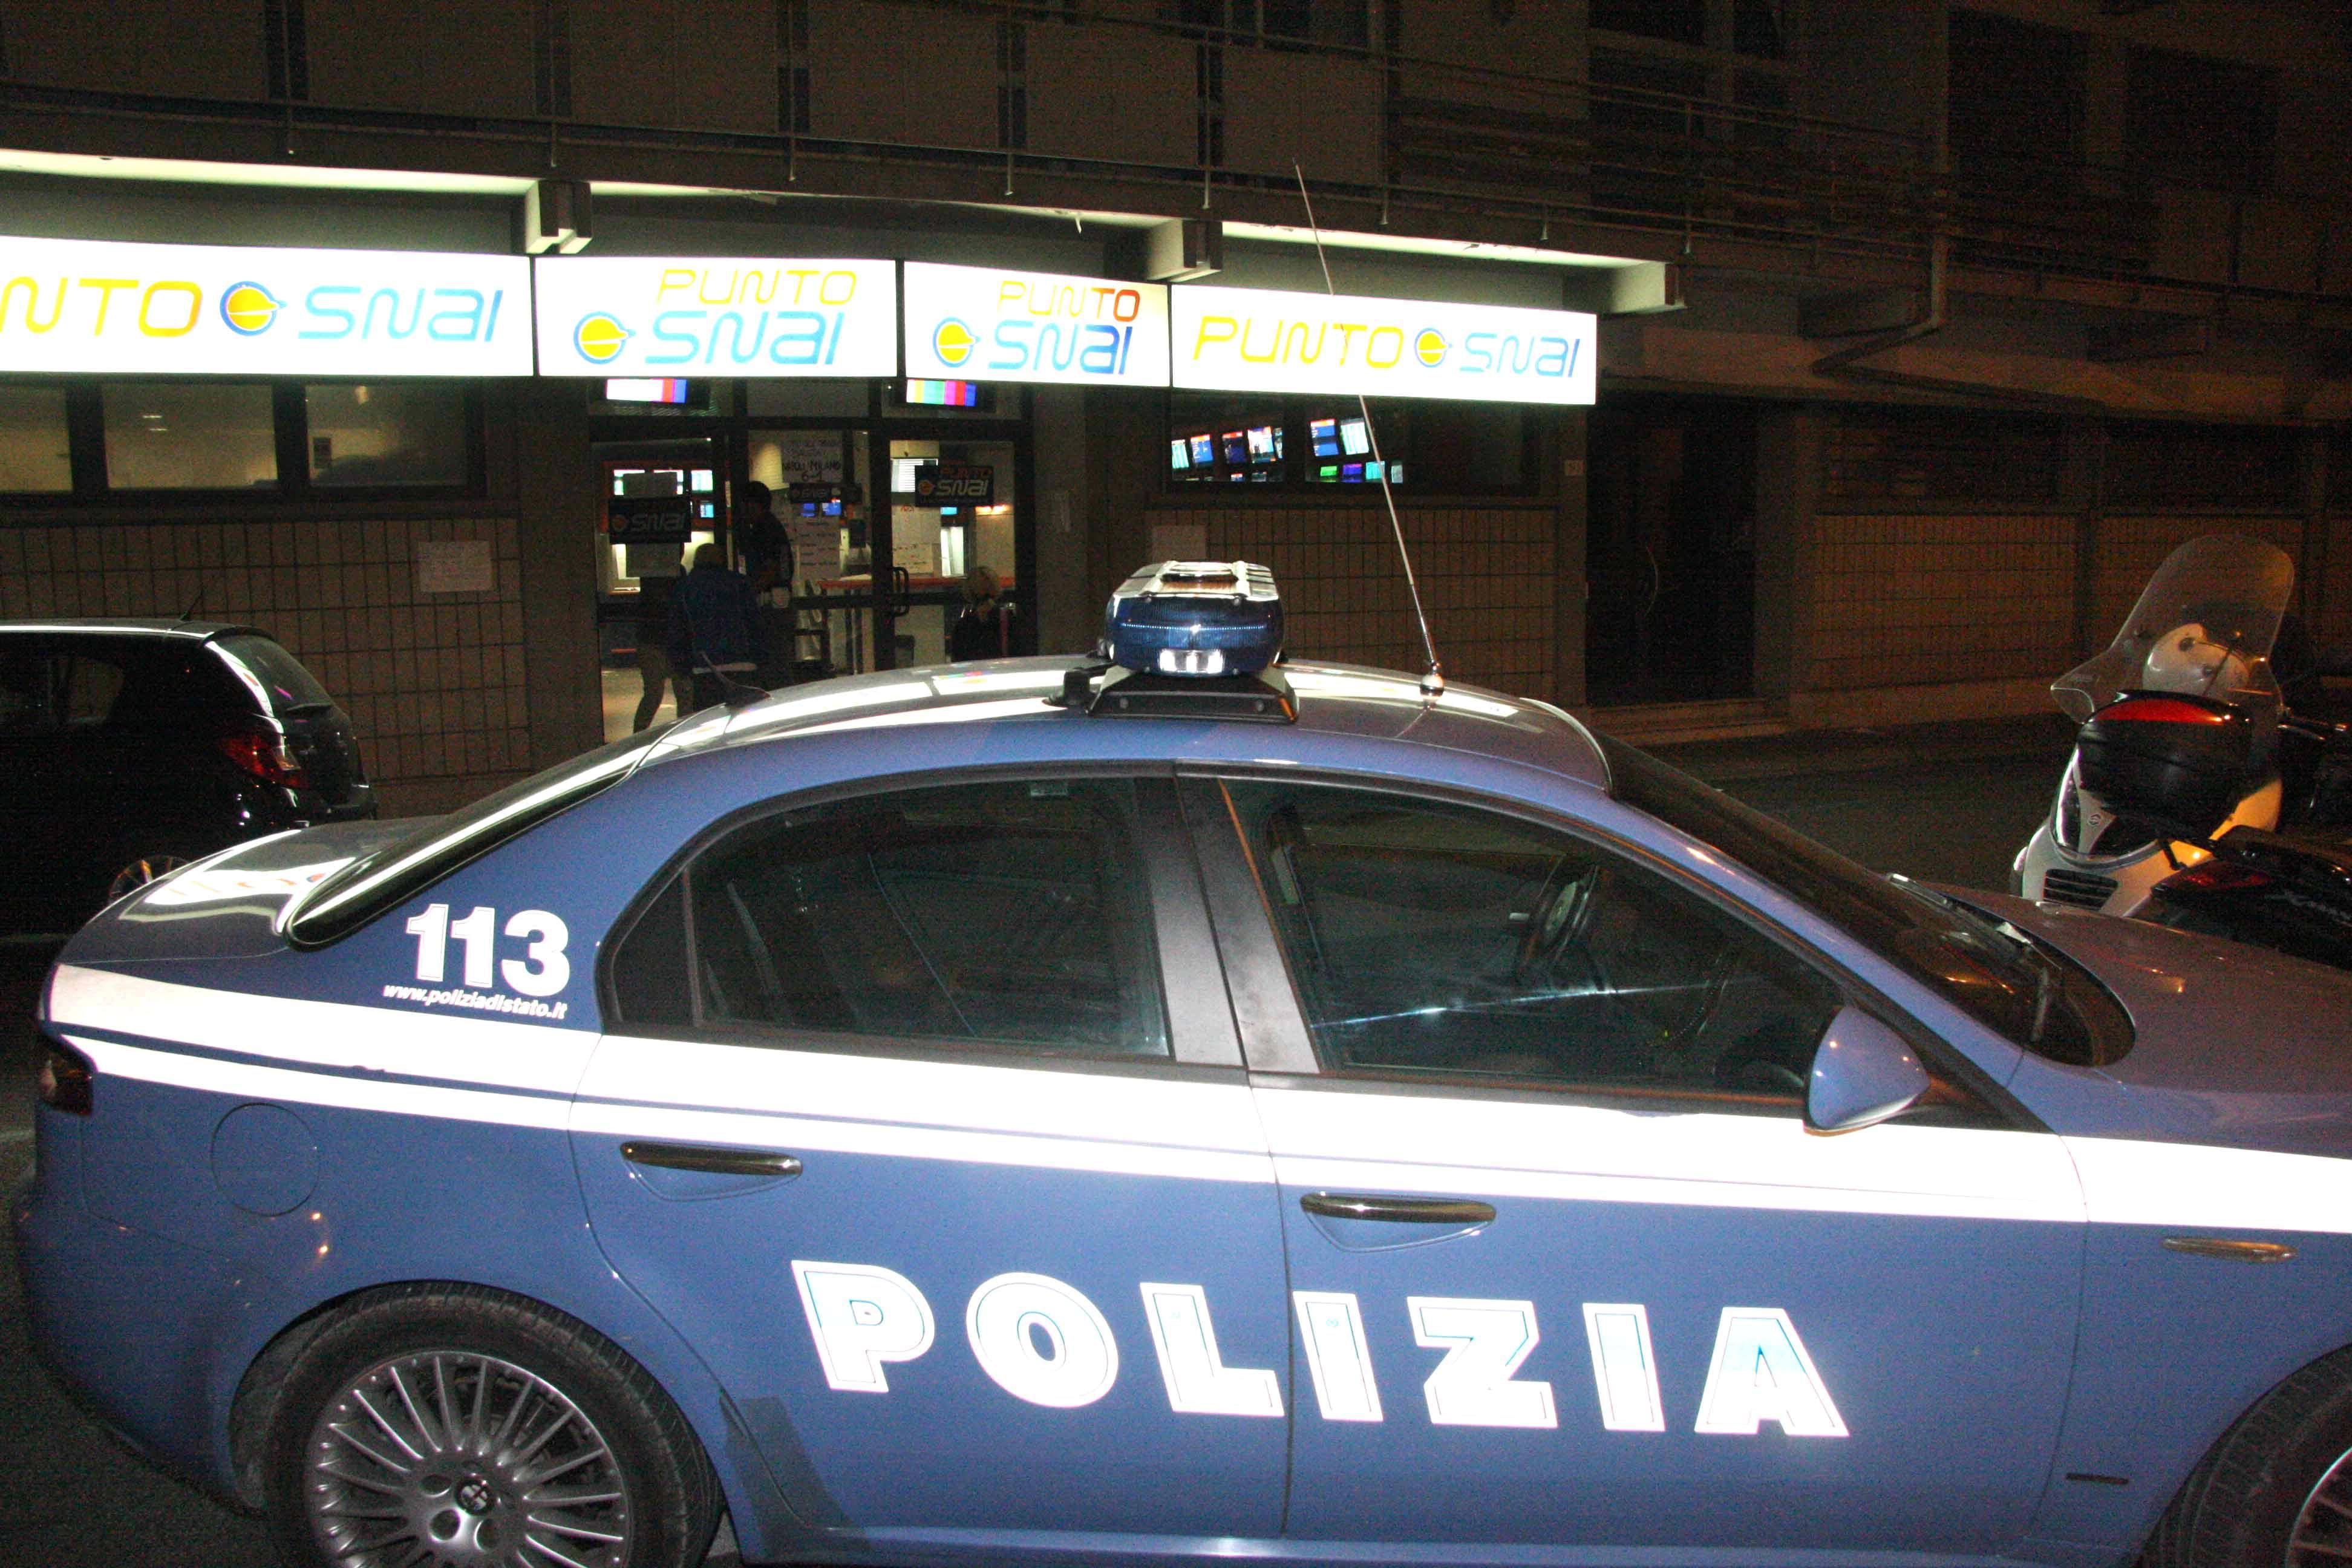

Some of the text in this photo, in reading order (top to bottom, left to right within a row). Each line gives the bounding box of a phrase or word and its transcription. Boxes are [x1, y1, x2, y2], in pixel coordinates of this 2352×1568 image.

[656, 269, 857, 305] PUNTO
[998, 281, 1140, 322] PUNTO
[1193, 316, 1403, 368] PUNTO
[406, 903, 570, 996] 113
[383, 985, 567, 1019] www.poliziadistato.it
[790, 1259, 1849, 1437] POLIZIA
